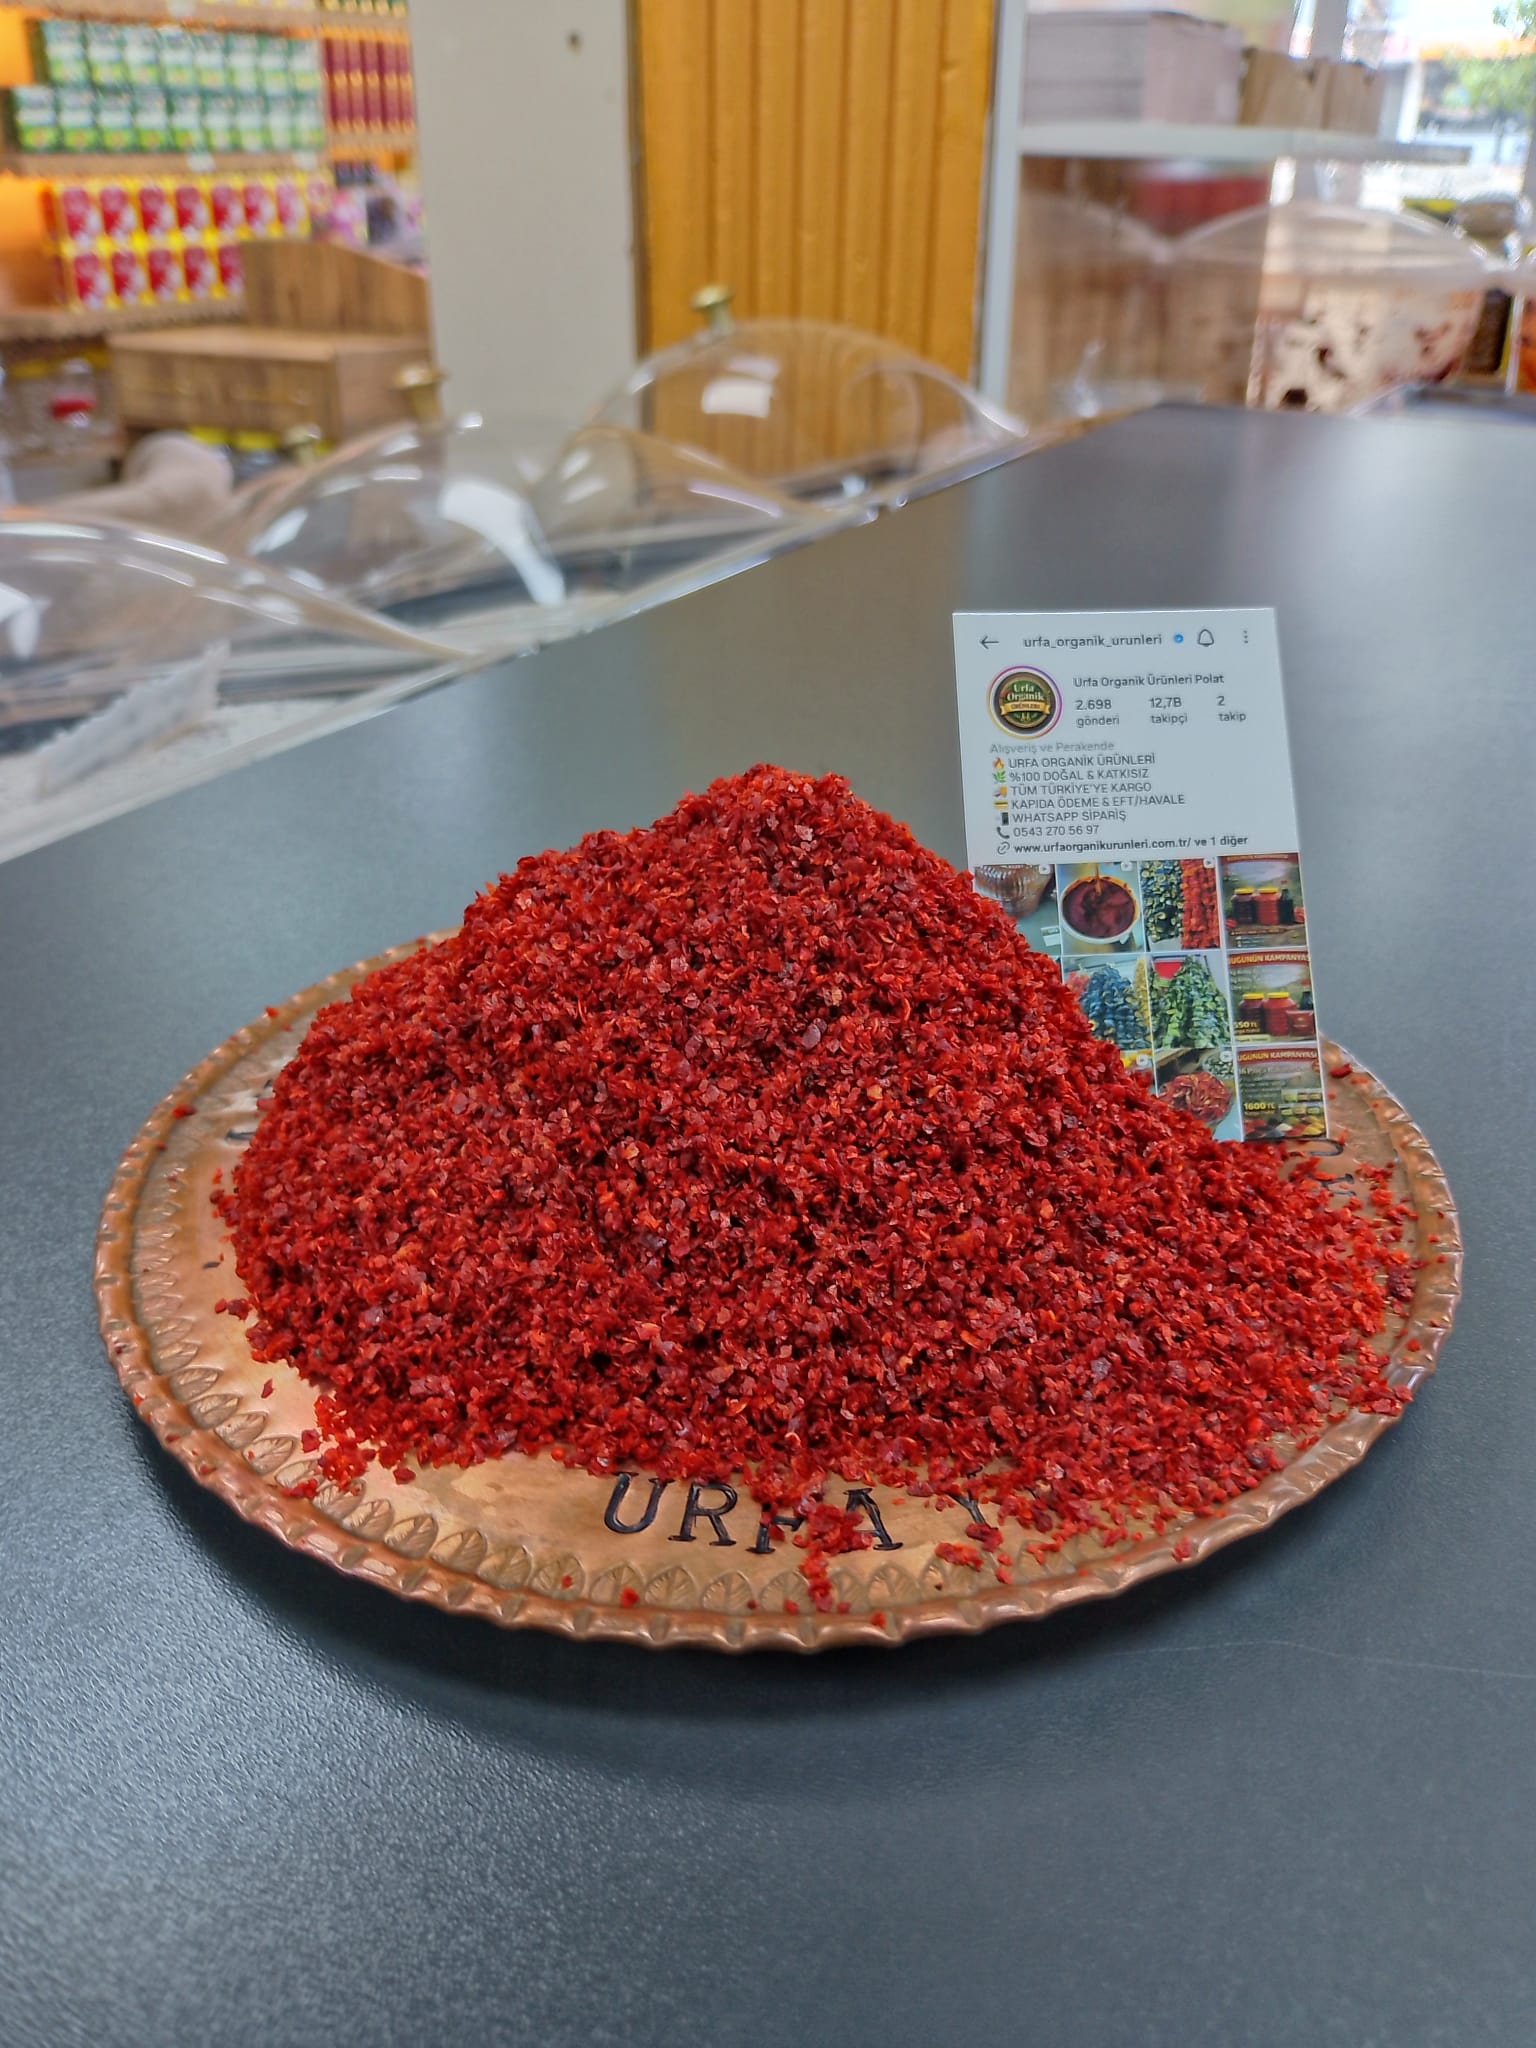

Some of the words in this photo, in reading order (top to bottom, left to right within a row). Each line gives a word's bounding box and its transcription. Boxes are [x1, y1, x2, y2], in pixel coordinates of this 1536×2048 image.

[1024, 634, 1163, 649] urfa_organik_urunleri
[1013, 683, 1035, 693] Urfa
[1073, 677, 1099, 688] Urfa
[1101, 676, 1145, 689] Organik
[1147, 673, 1192, 686] Ürünleri
[1195, 674, 1224, 685] Polat
[1075, 699, 1112, 710] 2.698
[1216, 696, 1225, 707] 2
[1076, 715, 1120, 728] gönderi
[1150, 713, 1188, 726] takipçi
[1218, 711, 1247, 723] takip
[1040, 744, 1053, 752] ve
[1056, 742, 1114, 752] Perakende
[1008, 758, 1039, 769] URFA
[1041, 755, 1094, 768] ORGANİK
[1097, 752, 1156, 766] ÜRÜNLERİ
[1009, 771, 1040, 782] %100
[1044, 768, 1084, 781] DOĞAL
[1097, 768, 1149, 780] KATKISIZ
[1011, 782, 1038, 796] TÜM
[1111, 782, 1152, 793] KARGO
[1011, 799, 1055, 810] KAPIDA
[1058, 796, 1100, 809] ÖDEME
[1113, 794, 1185, 807] EFT/HAVALE
[1012, 811, 1079, 823] WHATSAPP
[1081, 808, 1127, 823] SİPARİŞ
[1013, 827, 1043, 837] 0543
[1046, 826, 1066, 836] 270
[1068, 825, 1083, 836] 56
[1086, 824, 1099, 835] 97
[1014, 837, 1191, 854] www.urfaorganikurunleri.com.tr/
[1194, 838, 1207, 847] ve
[1220, 835, 1249, 848] diğer
